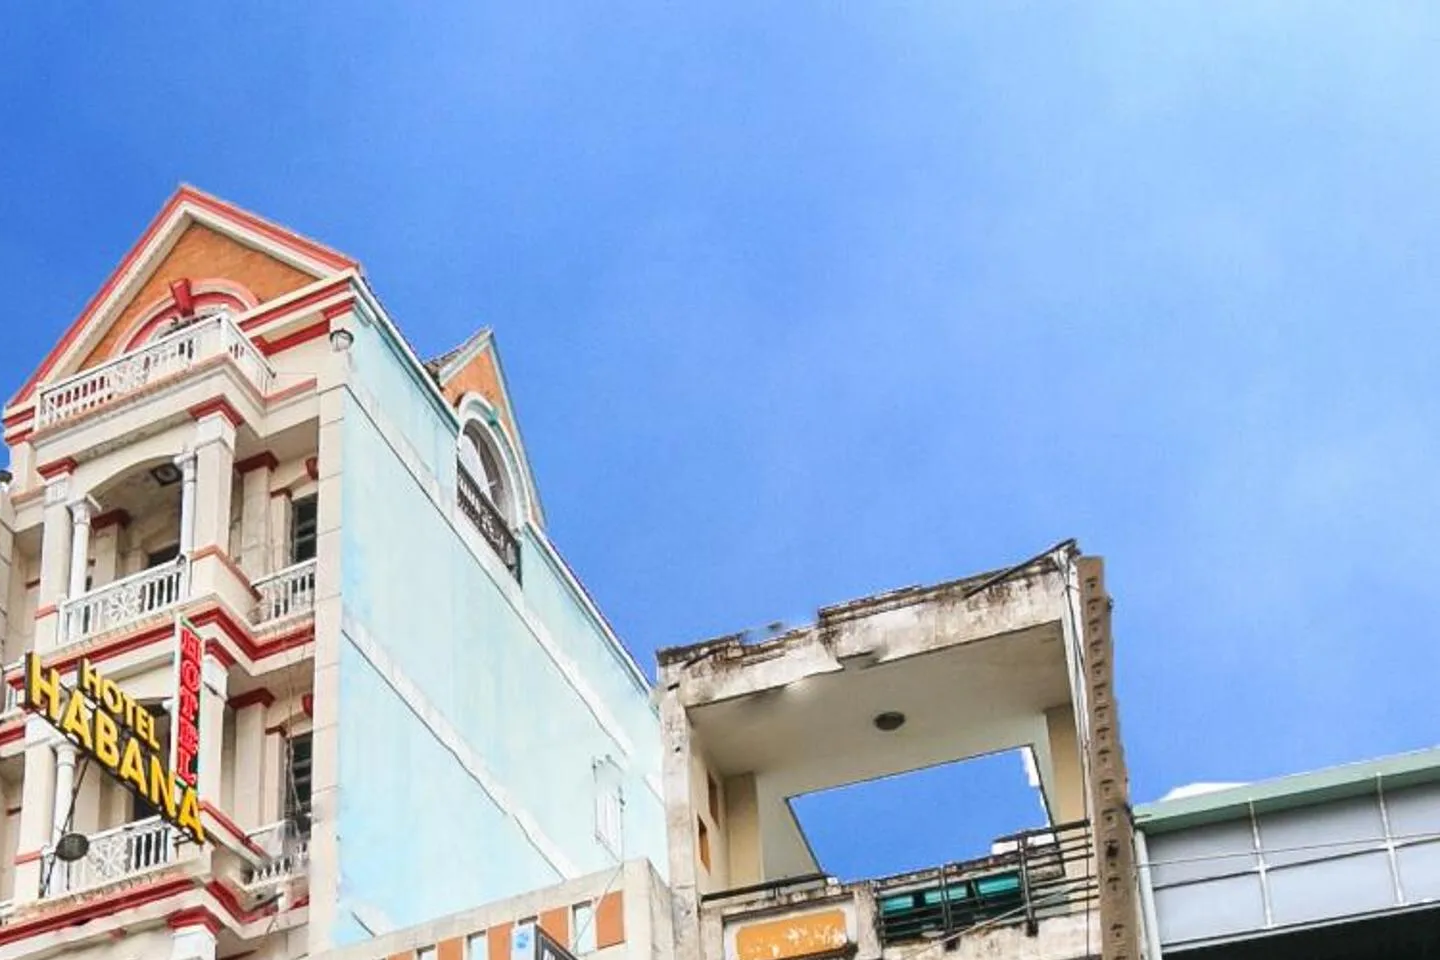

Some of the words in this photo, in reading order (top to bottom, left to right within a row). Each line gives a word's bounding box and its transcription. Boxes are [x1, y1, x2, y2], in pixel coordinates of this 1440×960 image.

[24, 651, 206, 845] HABANA
[78, 657, 161, 751] HOTEL
[177, 626, 202, 786] HOTEL
